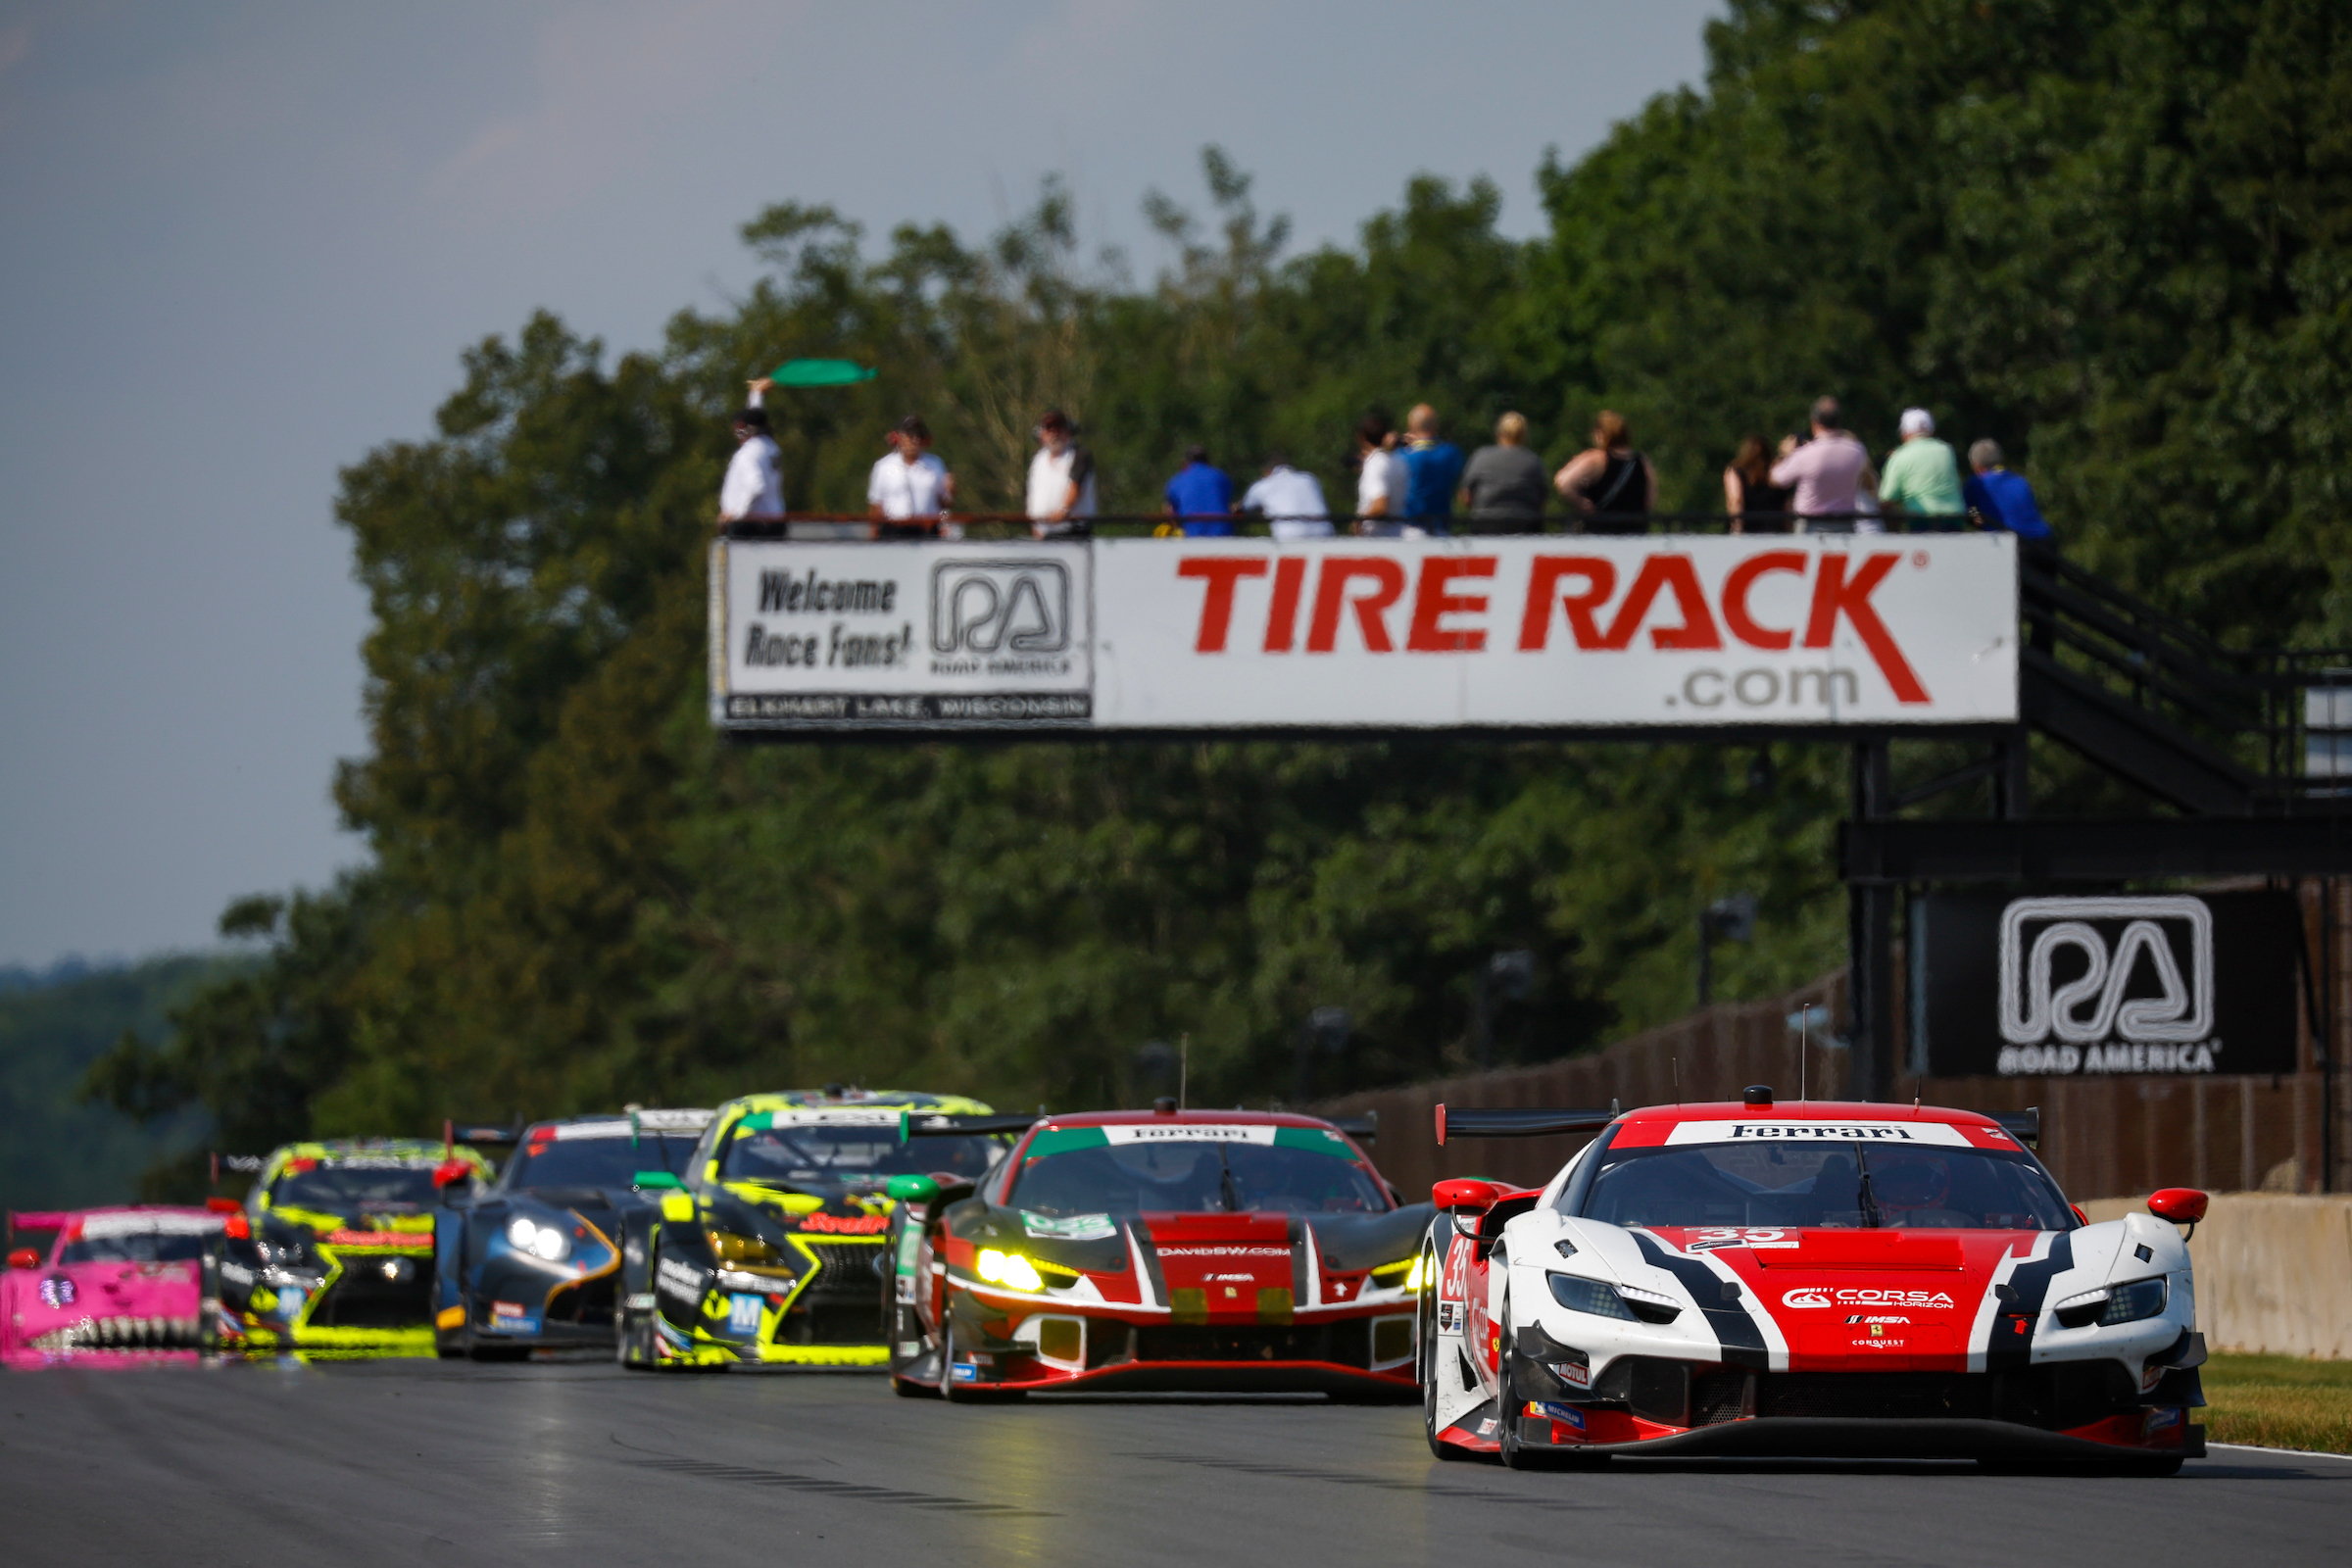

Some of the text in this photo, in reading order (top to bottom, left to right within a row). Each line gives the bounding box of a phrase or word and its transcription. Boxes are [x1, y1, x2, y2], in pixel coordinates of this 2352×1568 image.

[759, 566, 898, 613] Welcome
[1176, 551, 1935, 706] TIRE RACK
[745, 621, 912, 668] Race Fans!
[1664, 665, 1860, 709] .com
[729, 696, 851, 716] ELKHART
[939, 696, 1090, 718] WISCONSIN
[1996, 1042, 2216, 1075] ROAD AMERICA
[1133, 1127, 1248, 1139] Ferrari
[1727, 1124, 1915, 1140] Ferrari
[1697, 1228, 1786, 1242] 35
[1836, 1289, 1954, 1303] CORSA
[1864, 1315, 1911, 1324] IMSA
[1851, 1339, 1905, 1348] CONQUEST
[1559, 1363, 1588, 1383] MOTUL
[1547, 1404, 1581, 1423] MICHELIN
